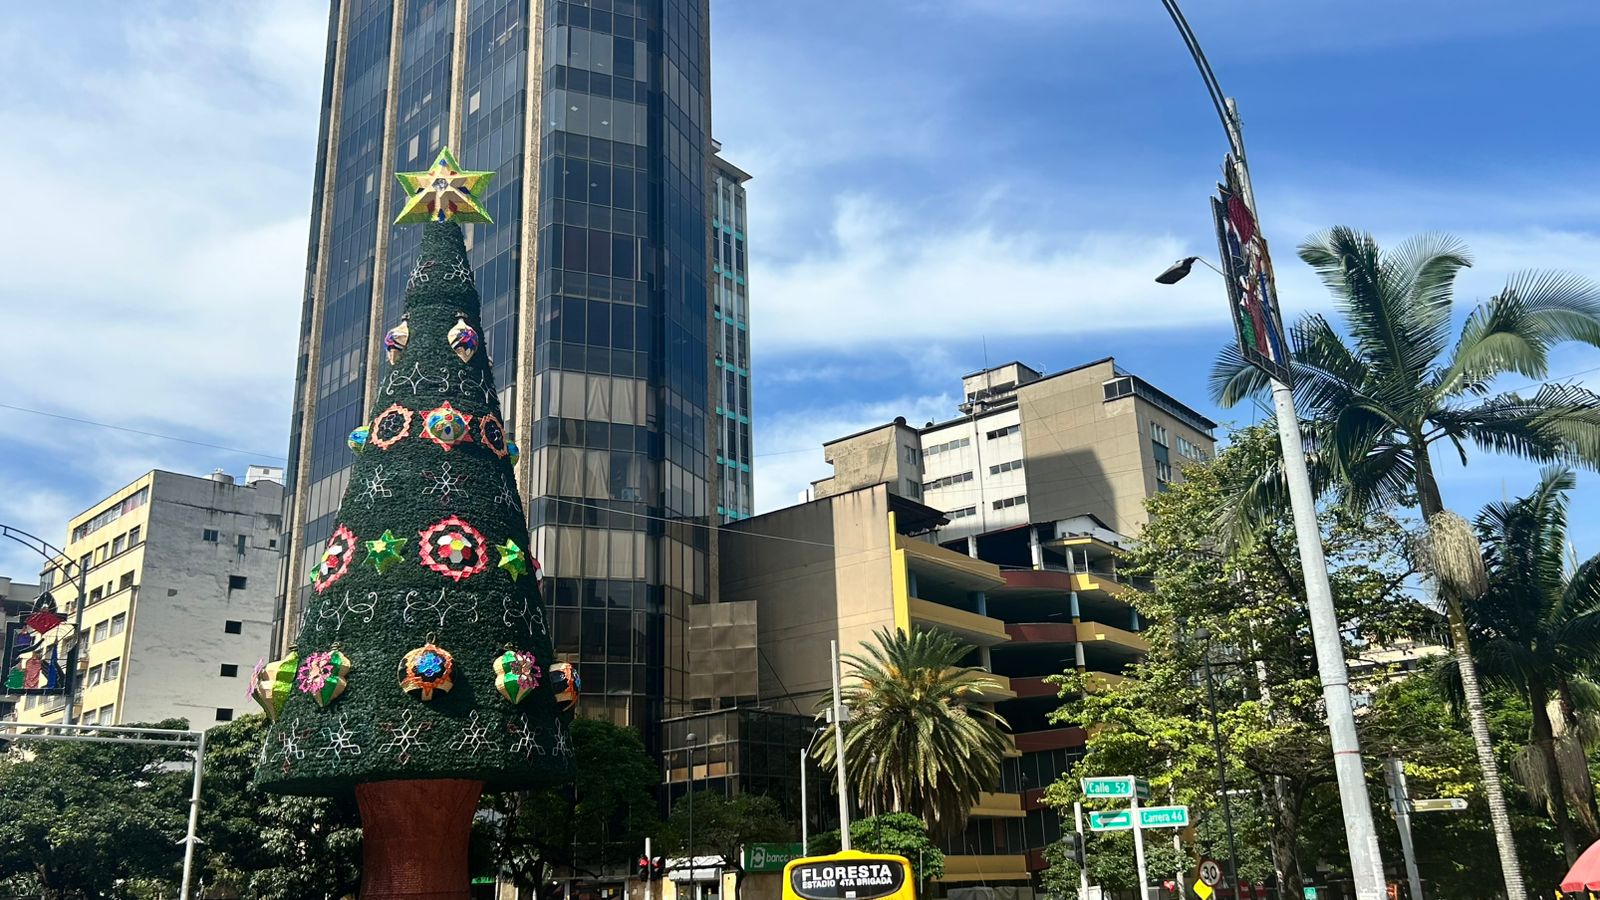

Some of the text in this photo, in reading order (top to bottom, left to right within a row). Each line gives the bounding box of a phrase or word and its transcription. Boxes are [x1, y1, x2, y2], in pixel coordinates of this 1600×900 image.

[1089, 782, 1126, 793] Calle 52
[1143, 811, 1183, 823] Carrera 46
[801, 864, 893, 881] FLORESTA
[1202, 866, 1218, 880] 30
[802, 876, 893, 889] ESTADIO 4TA BRIGADA
